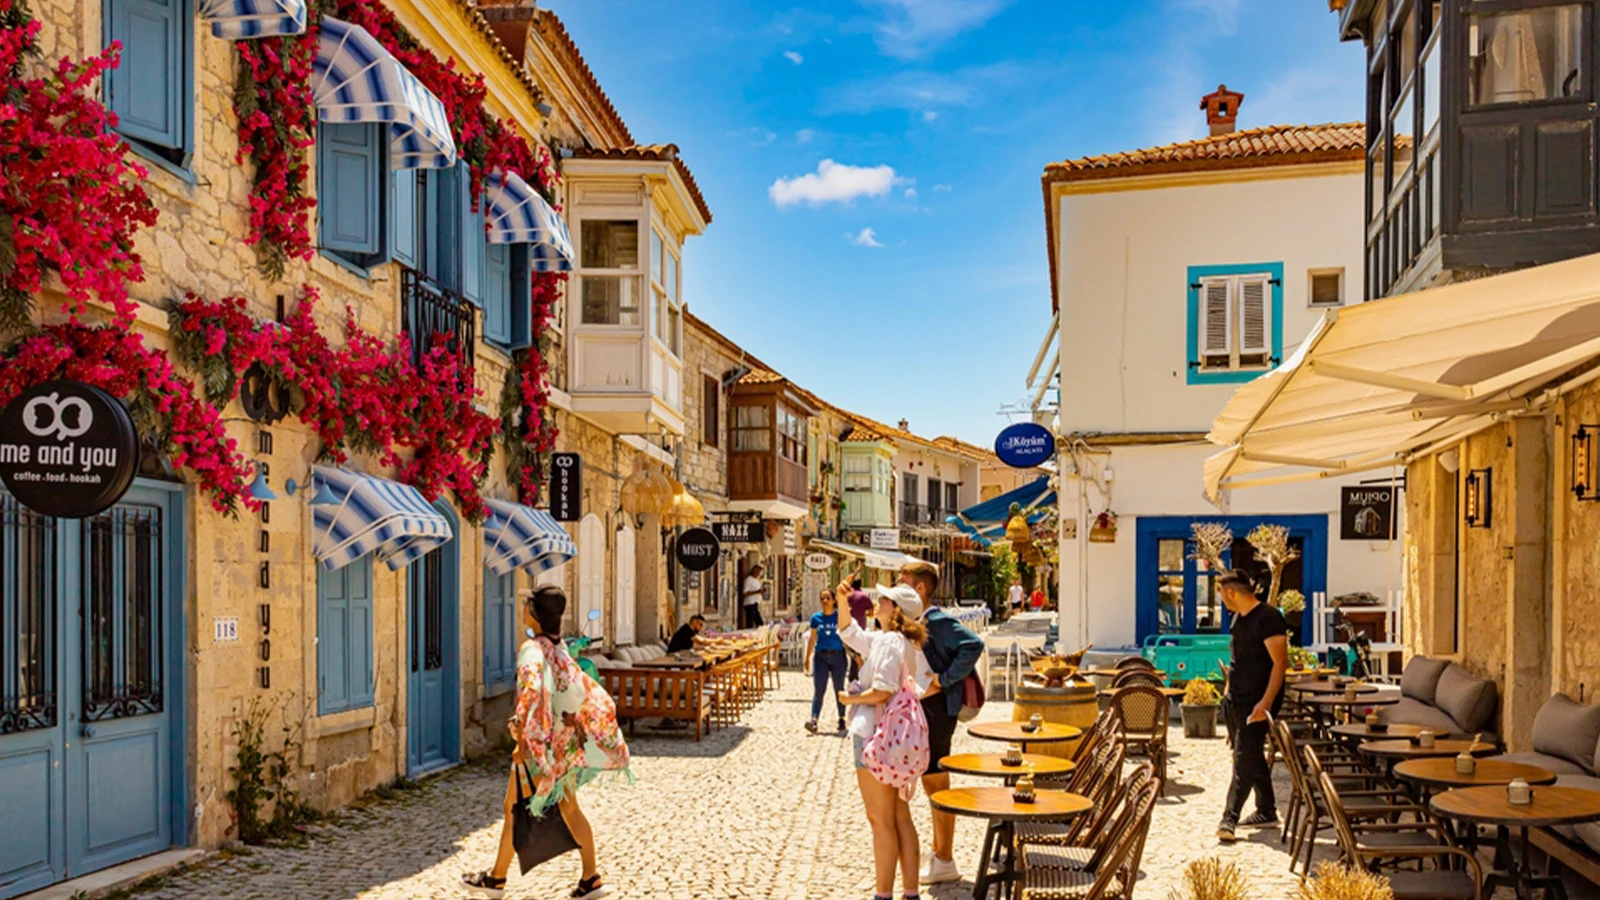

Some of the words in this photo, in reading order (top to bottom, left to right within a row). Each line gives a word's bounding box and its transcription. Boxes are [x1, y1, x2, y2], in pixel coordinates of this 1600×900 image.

[0, 444, 30, 463] me
[38, 442, 75, 465] and
[80, 447, 117, 472] you
[13, 471, 41, 481] coffee
[46, 472, 66, 482] food
[70, 474, 101, 484] hookah
[261, 501, 270, 589] and
[682, 543, 713, 557] MOST
[217, 622, 235, 638] 118
[261, 604, 270, 689] you
